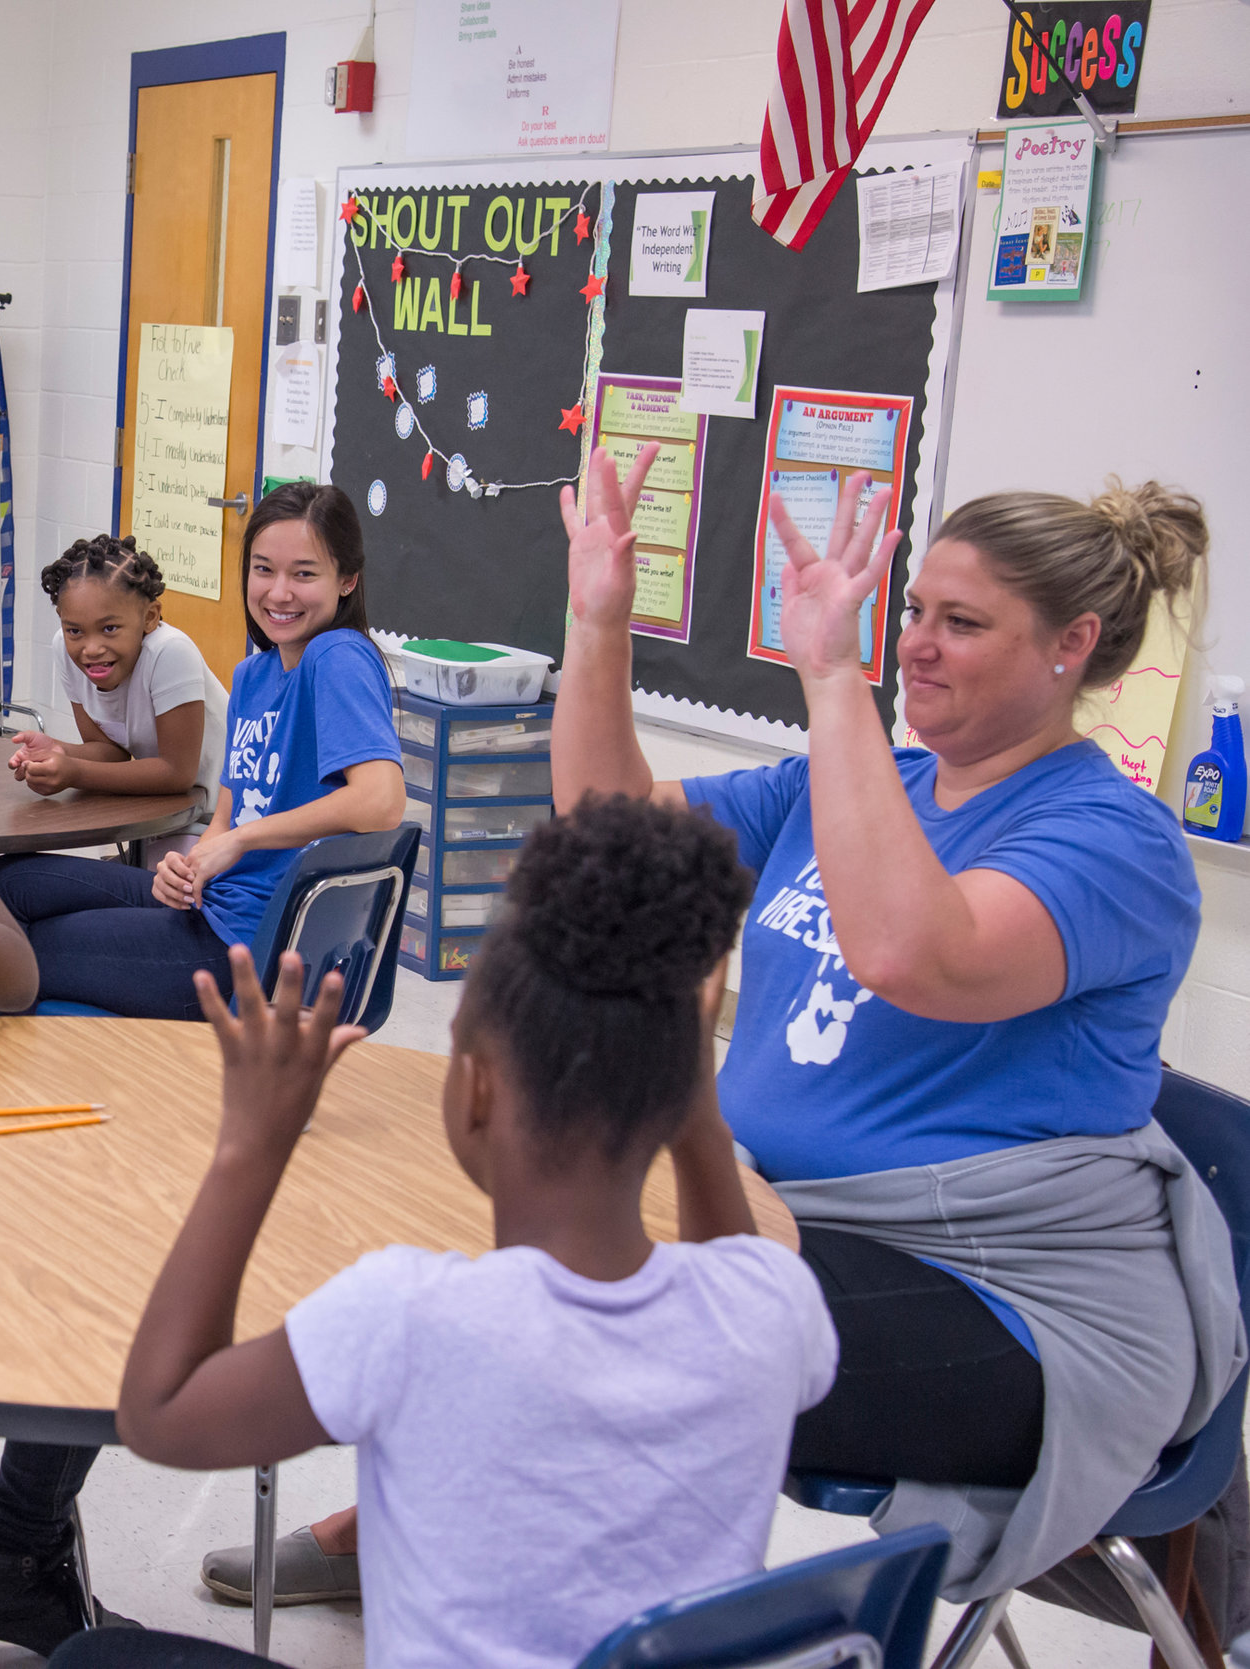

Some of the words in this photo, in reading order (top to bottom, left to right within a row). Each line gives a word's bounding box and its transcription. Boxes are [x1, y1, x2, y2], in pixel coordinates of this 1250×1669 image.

[459, 14, 489, 27] Collaborate
[458, 31, 472, 43] Bring
[473, 28, 497, 40] materials
[516, 45, 522, 55] A
[508, 59, 516, 70] Be
[517, 58, 535, 69] honest
[507, 74, 522, 84] Admit
[523, 72, 547, 83] mistakes
[506, 88, 530, 100] Uniforms
[542, 106, 549, 116] R
[521, 120, 529, 131] Do
[530, 121, 543, 133] your
[544, 119, 557, 131] best
[518, 136, 528, 147] Ask
[529, 135, 558, 148] questions
[559, 134, 577, 145] when
[579, 133, 586, 144] in
[587, 132, 606, 144] doubt
[1015, 136, 1086, 161] Poetry
[350, 195, 470, 251] SHOUT
[484, 195, 571, 257] OUT
[660, 224, 680, 237] Word
[642, 244, 693, 256] Independent
[652, 261, 682, 276] Writing
[393, 277, 493, 337] WALL
[172, 327, 182, 353] to
[626, 391, 645, 402] TASK,
[637, 404, 669, 413] AUDIENCE
[803, 406, 816, 417] AN
[818, 408, 874, 423] ARGUMENT
[788, 429, 811, 438] argument
[862, 437, 880, 446] opinion
[882, 439, 891, 447] and
[781, 474, 805, 482] Argument
[806, 473, 827, 481] Checklist
[178, 545, 196, 570] help
[1194, 765, 1220, 781] EXPO
[756, 886, 831, 949] VIBES
